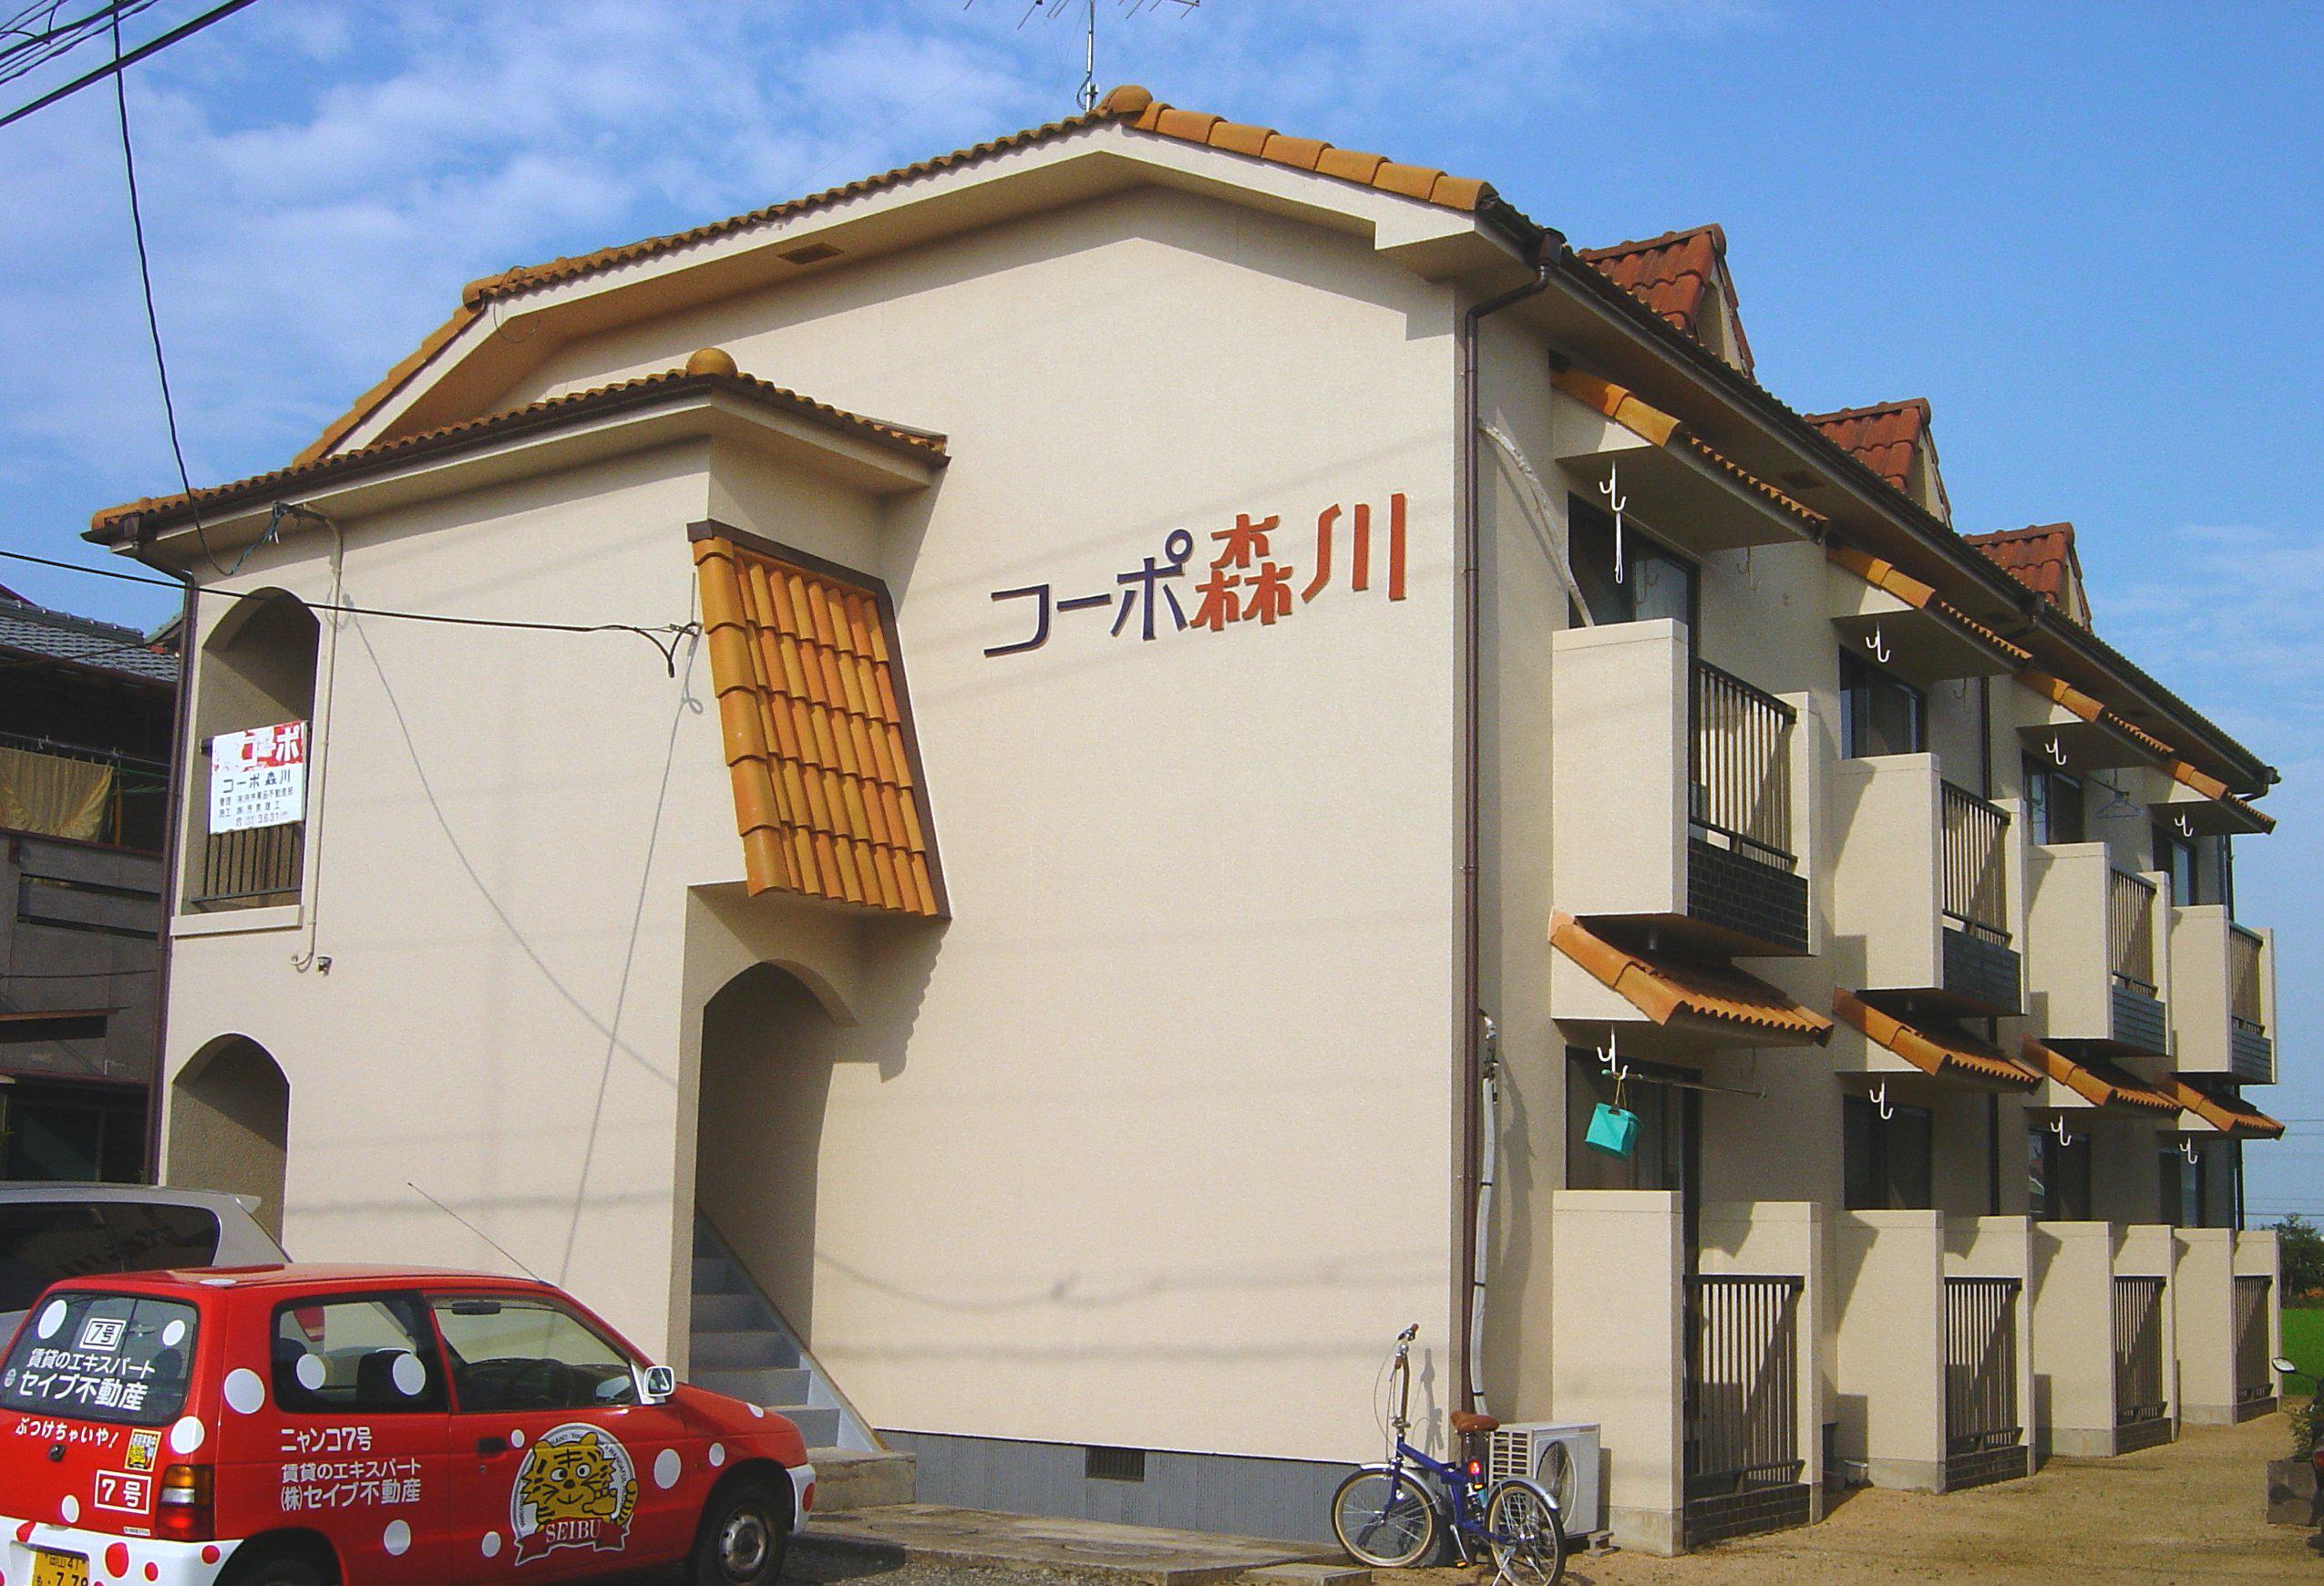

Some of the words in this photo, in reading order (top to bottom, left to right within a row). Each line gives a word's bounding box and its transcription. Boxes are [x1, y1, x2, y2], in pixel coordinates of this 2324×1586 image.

[983, 492, 1407, 658] コーポ森川
[90, 1324, 116, 1344] 7号
[26, 1348, 156, 1380] 賃貸のエキスパート
[19, 1370, 149, 1411] セイブ不動産
[281, 1426, 373, 1453] ニャンコ7号
[282, 1457, 421, 1483] 賃貸のエキスパート
[102, 1478, 142, 1508] 7号
[546, 1519, 602, 1542] SEIBU
